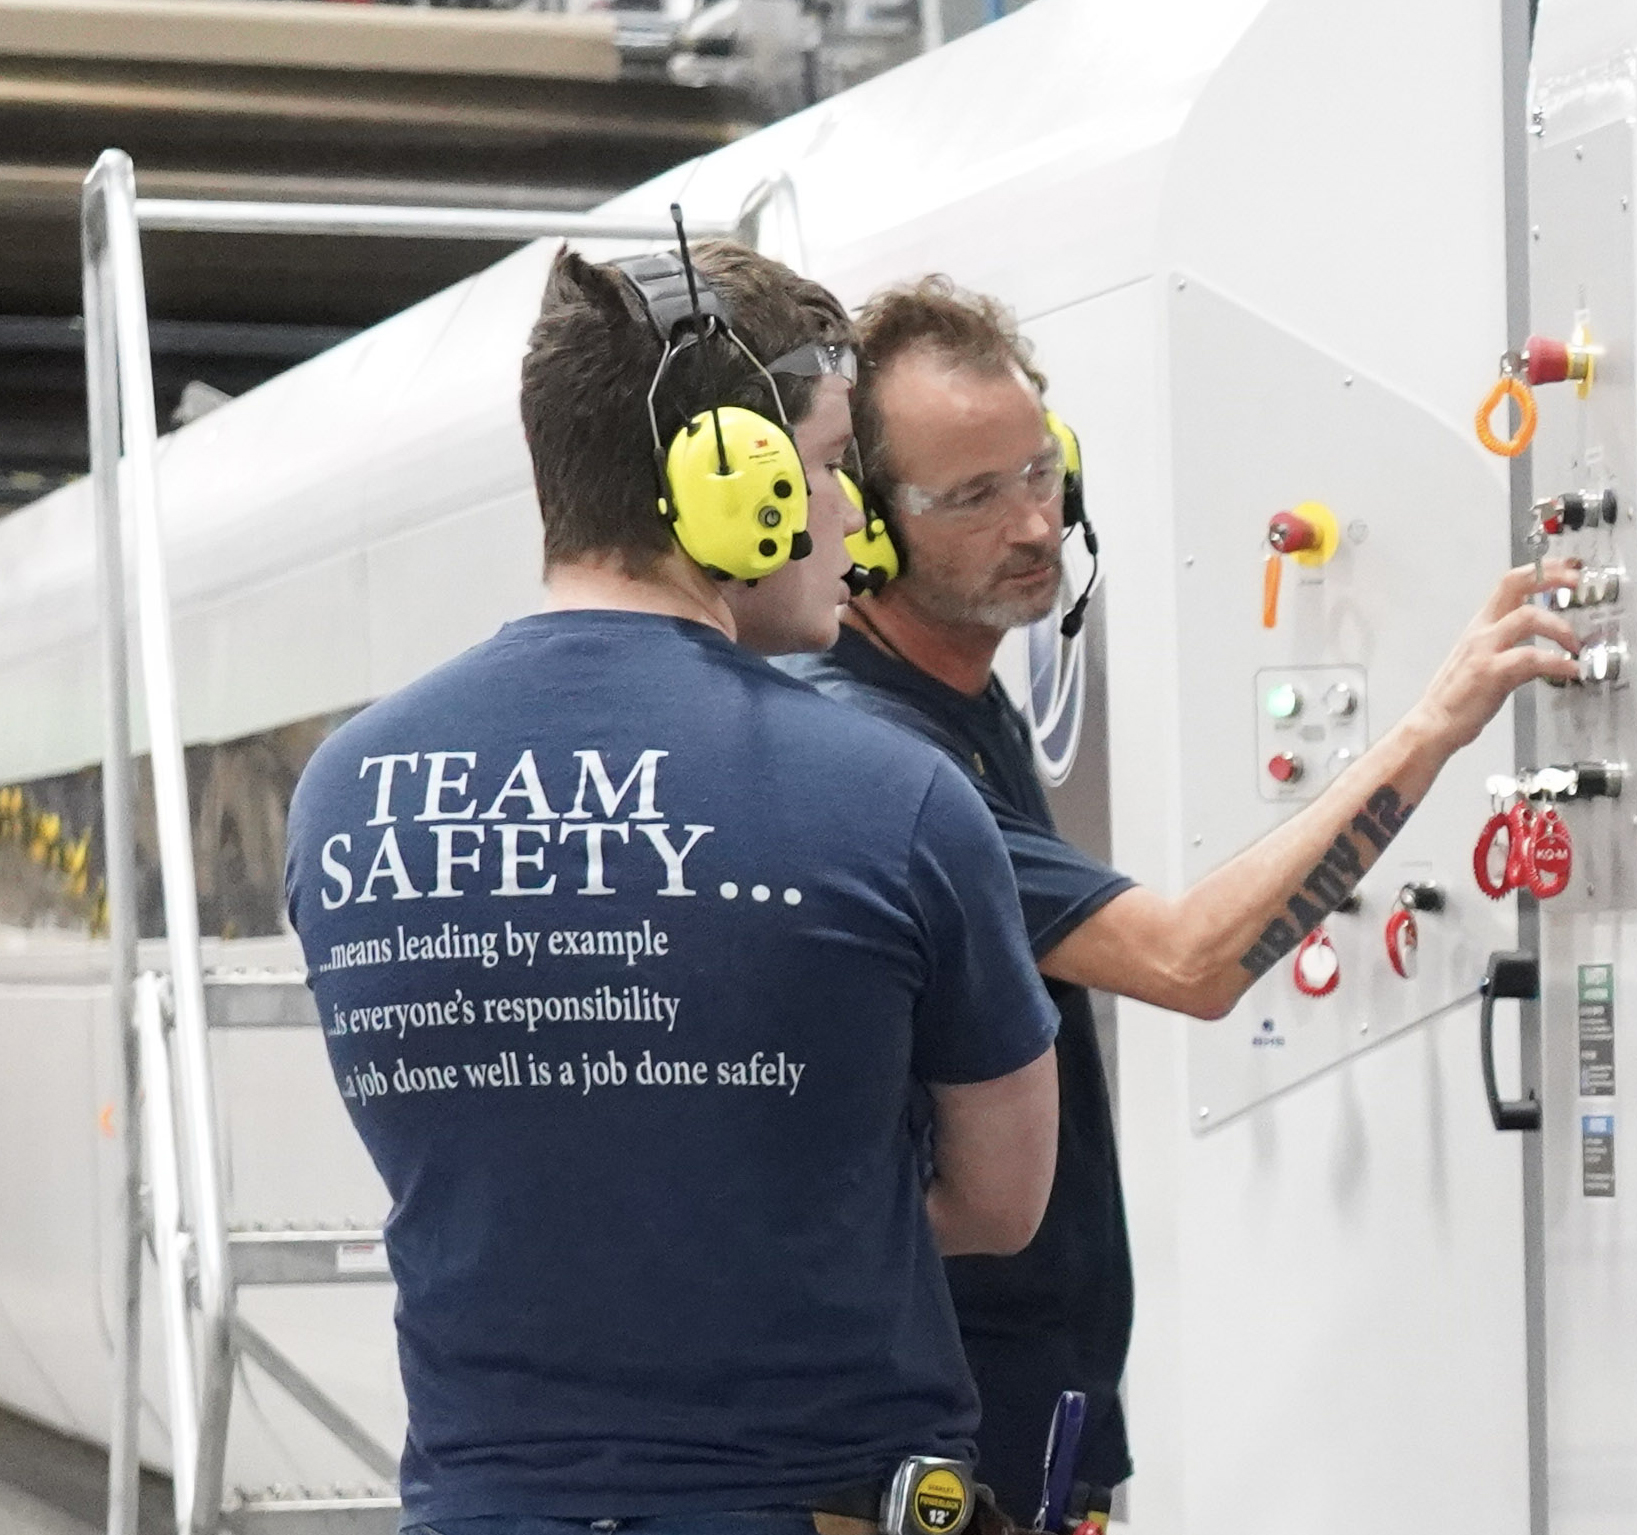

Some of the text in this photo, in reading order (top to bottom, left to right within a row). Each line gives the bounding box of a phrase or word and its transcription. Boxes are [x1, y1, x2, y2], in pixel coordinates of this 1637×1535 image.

[359, 749, 669, 826] TEAM
[397, 922, 499, 968] leading
[504, 920, 541, 967] by
[548, 919, 669, 967] example
[350, 988, 476, 1040] everyone's
[484, 985, 681, 1033] responsibility
[354, 1061, 388, 1107] job
[393, 1057, 459, 1094] done
[463, 1051, 522, 1088] well
[527, 1052, 552, 1087] is
[558, 1060, 576, 1087] a
[581, 1049, 627, 1097] job
[635, 1050, 708, 1087] done
[716, 1051, 807, 1097] safely
